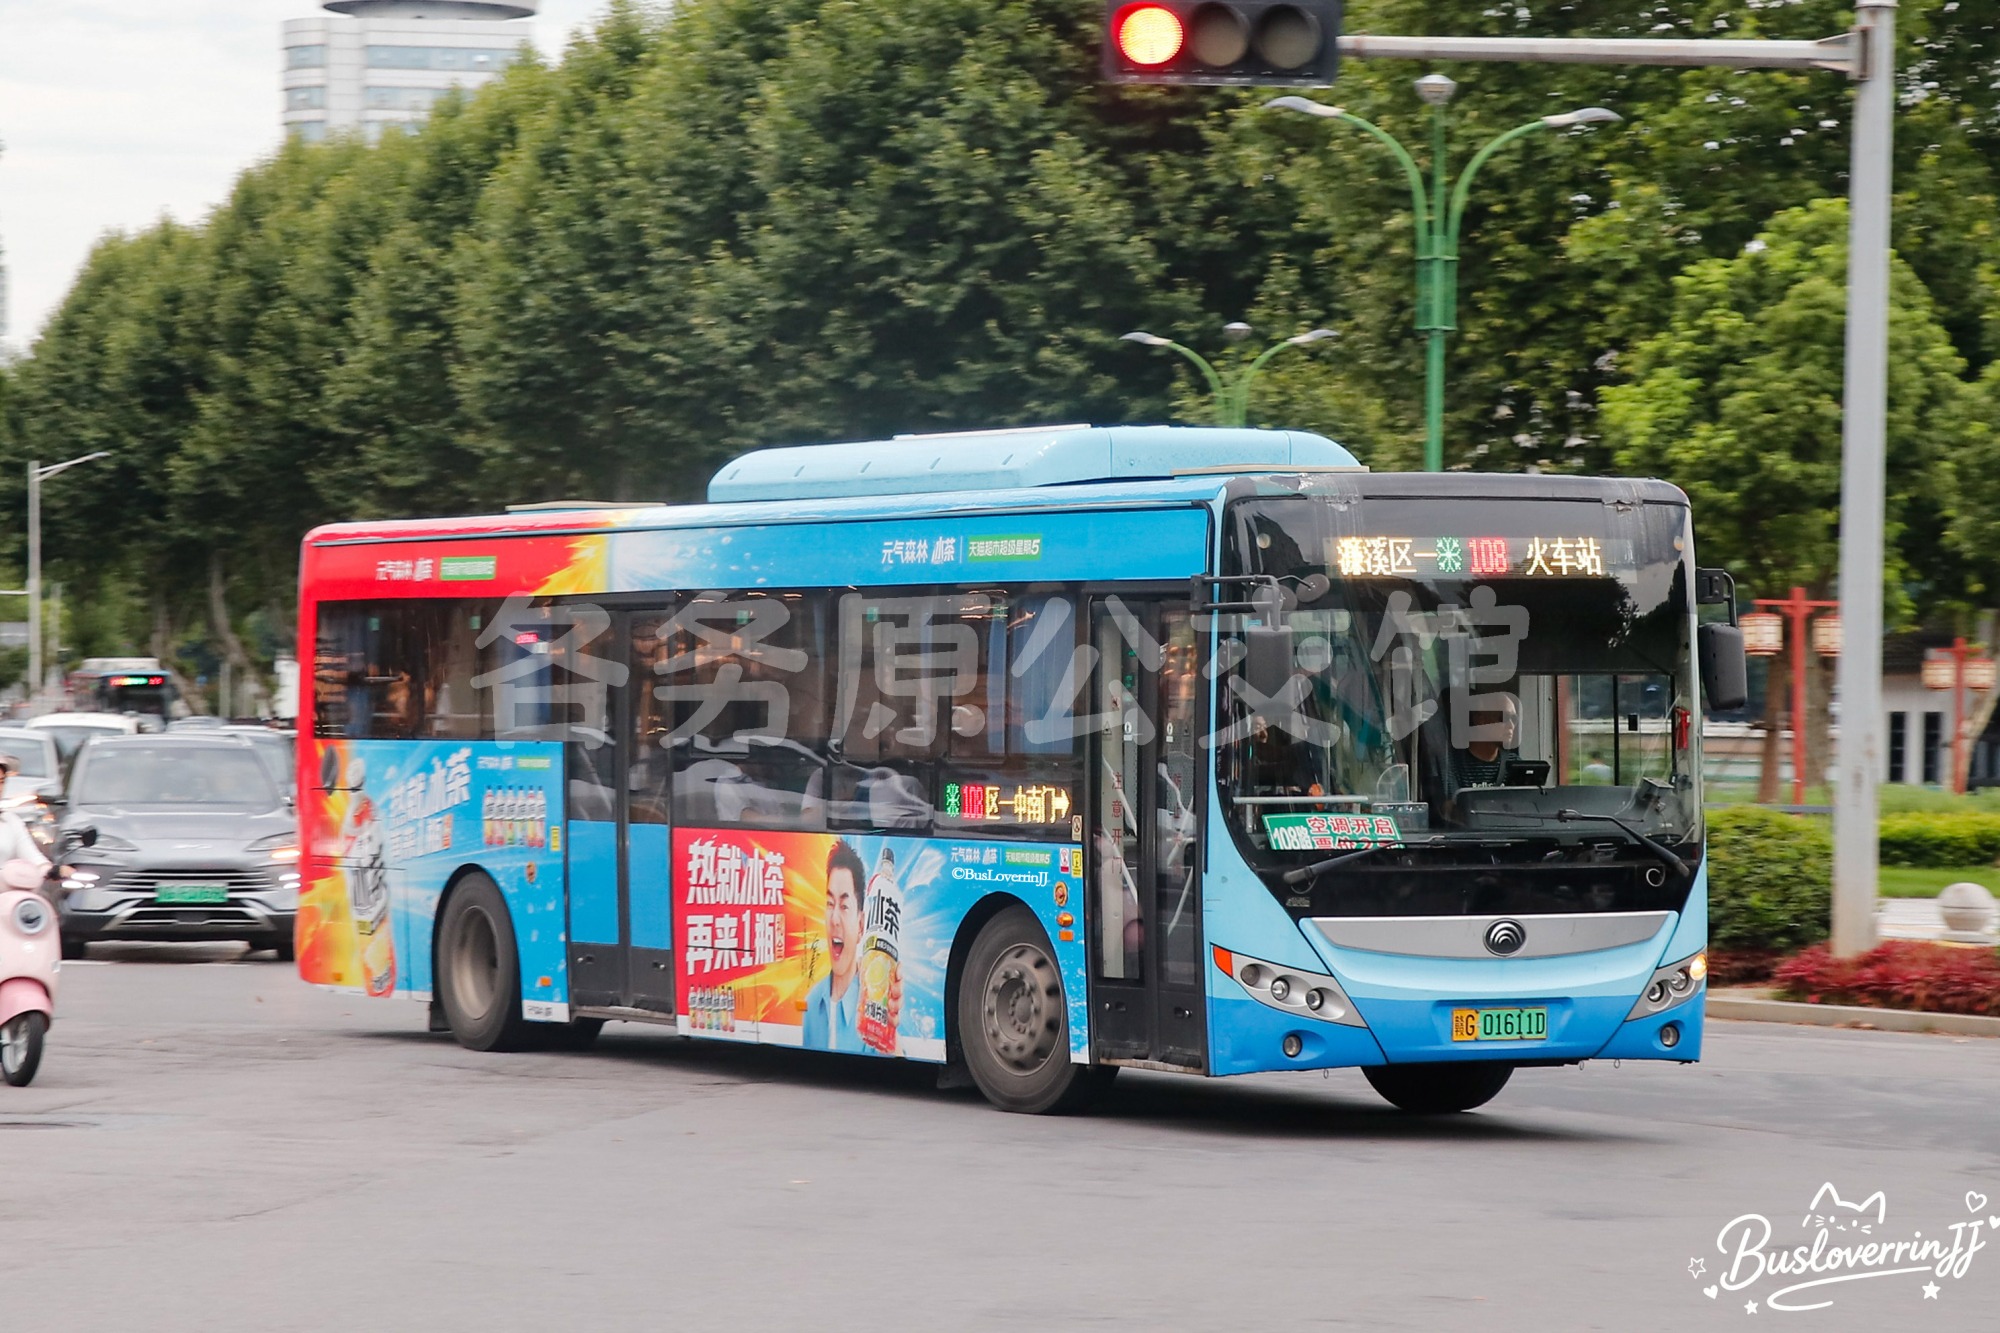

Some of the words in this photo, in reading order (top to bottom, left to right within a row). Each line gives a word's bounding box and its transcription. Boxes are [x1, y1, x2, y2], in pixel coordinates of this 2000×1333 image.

[881, 540, 928, 564] 元气森林
[1468, 539, 1508, 573] 108
[1526, 537, 1602, 576] 火车站
[962, 785, 984, 819] 108
[1306, 816, 1395, 836] 空调开启
[686, 835, 785, 906] 热就冰茶
[866, 889, 901, 942] 冰茶
[686, 910, 776, 976] 再来1瓶
[1483, 1012, 1545, 1036] 01611D
